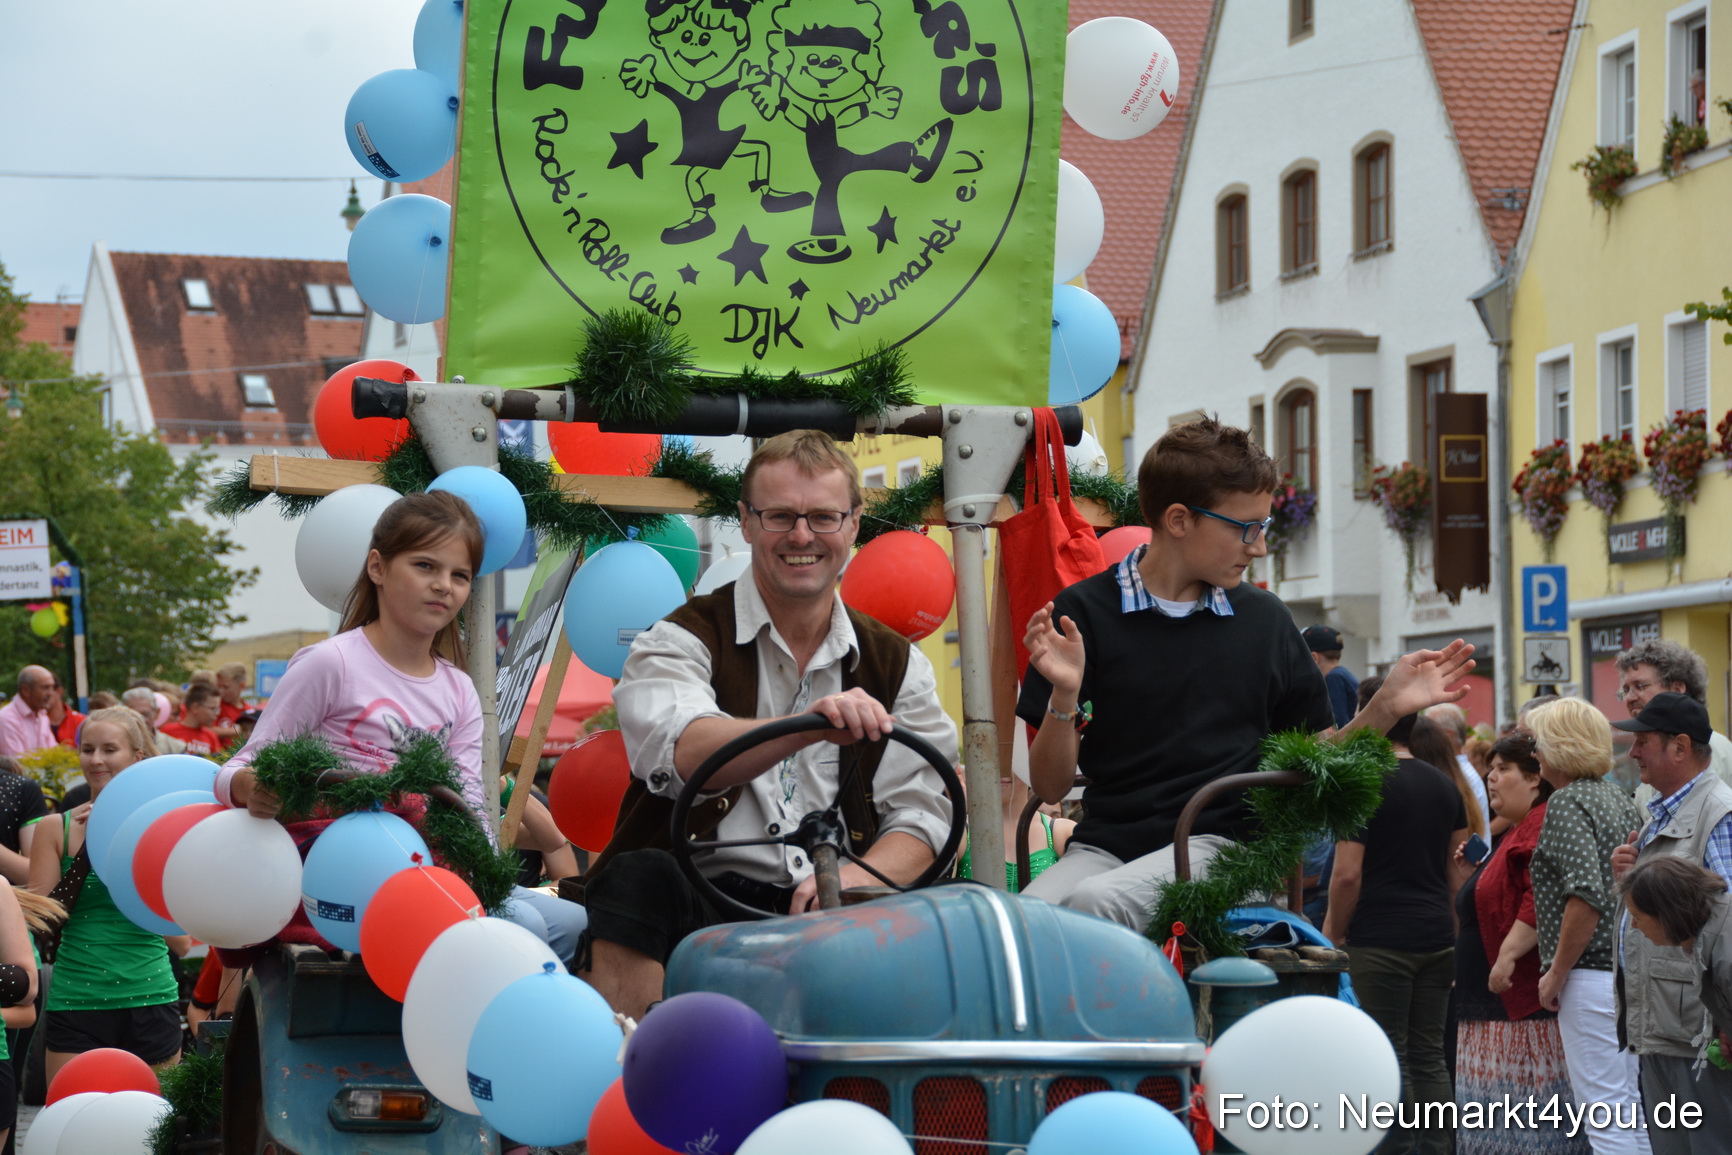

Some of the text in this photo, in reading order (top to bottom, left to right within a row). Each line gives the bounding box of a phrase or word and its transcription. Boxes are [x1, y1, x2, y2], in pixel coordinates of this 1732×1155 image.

[1120, 51, 1159, 116] www.fgh-info.de
[1153, 56, 1170, 87] Warum
[720, 303, 804, 360] DJK
[827, 218, 961, 331] Neumarkt
[953, 149, 985, 202] e.V.
[1532, 573, 1558, 625] P
